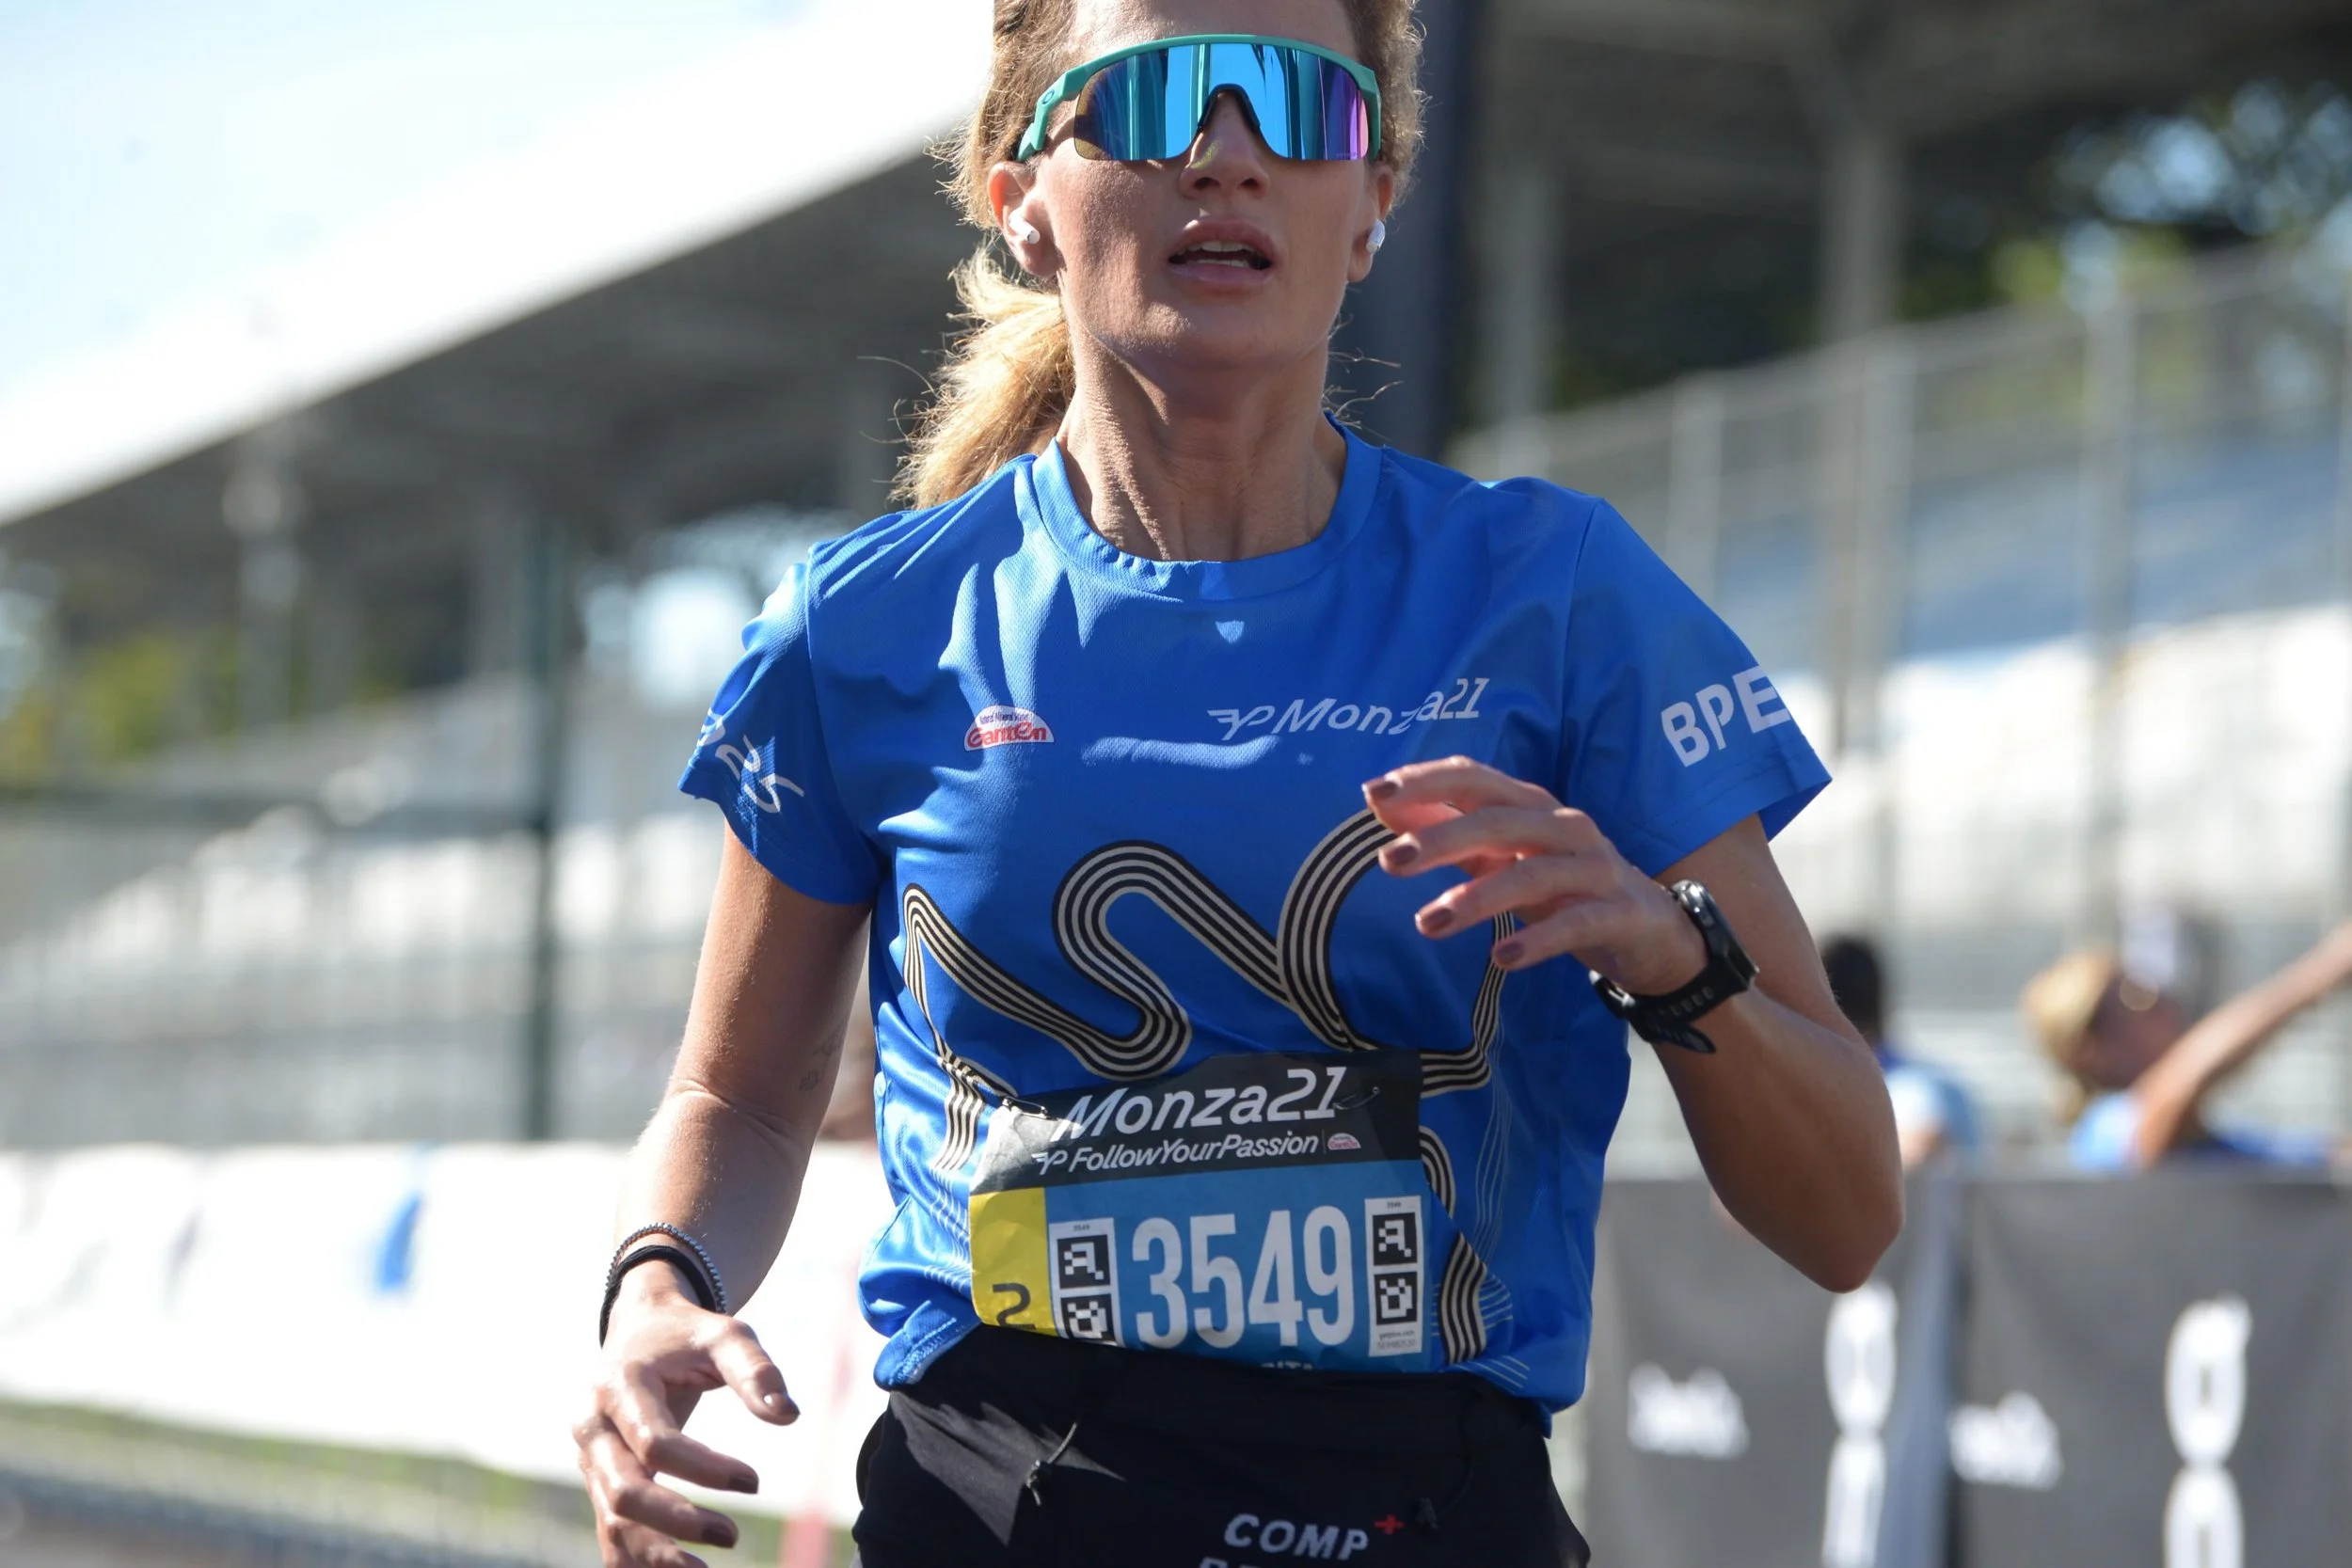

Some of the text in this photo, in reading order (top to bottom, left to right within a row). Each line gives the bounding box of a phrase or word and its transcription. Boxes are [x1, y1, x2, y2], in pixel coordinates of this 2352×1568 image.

[1271, 677, 1489, 736] Monza21
[1661, 665, 1791, 768] BPE
[1050, 1067, 1347, 1143] Monza21
[1068, 1131, 1319, 1174] FollowYourPassion
[993, 1282, 1037, 1329] 2
[1132, 1205, 1355, 1349] 3549
[1224, 1513, 1369, 1560] COMP
